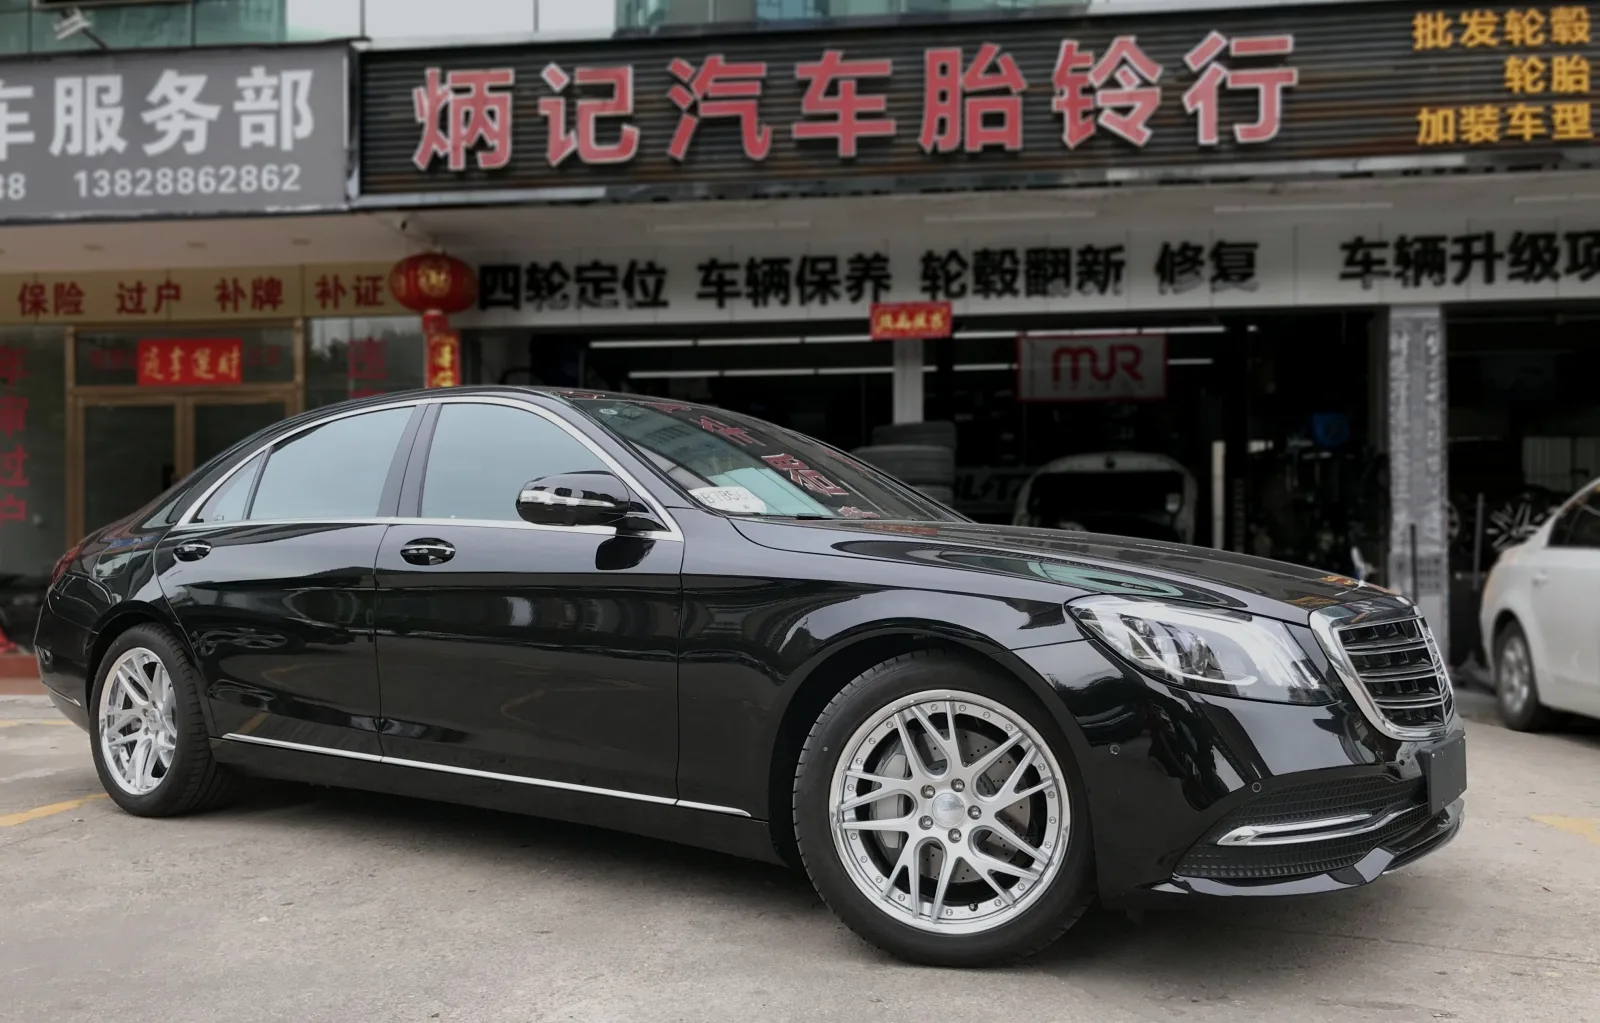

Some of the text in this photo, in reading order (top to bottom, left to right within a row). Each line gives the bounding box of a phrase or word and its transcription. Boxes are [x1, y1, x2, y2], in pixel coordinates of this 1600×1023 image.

[1411, 6, 1592, 51] 批发轮毂
[1504, 54, 1592, 94] 轮胎
[411, 30, 1298, 170] 炳记汽车胎铃行
[1416, 102, 1594, 146] 加装车型
[74, 164, 301, 198] 13828862862
[18, 281, 85, 316] 保险
[116, 279, 182, 315] 过户
[215, 276, 284, 313] 补牌
[315, 274, 386, 310] 补证
[478, 258, 669, 312] 四轮定位
[697, 252, 892, 308] 车辆保养
[920, 244, 1126, 300] 轮毂翻新
[1155, 241, 1259, 294] 修复
